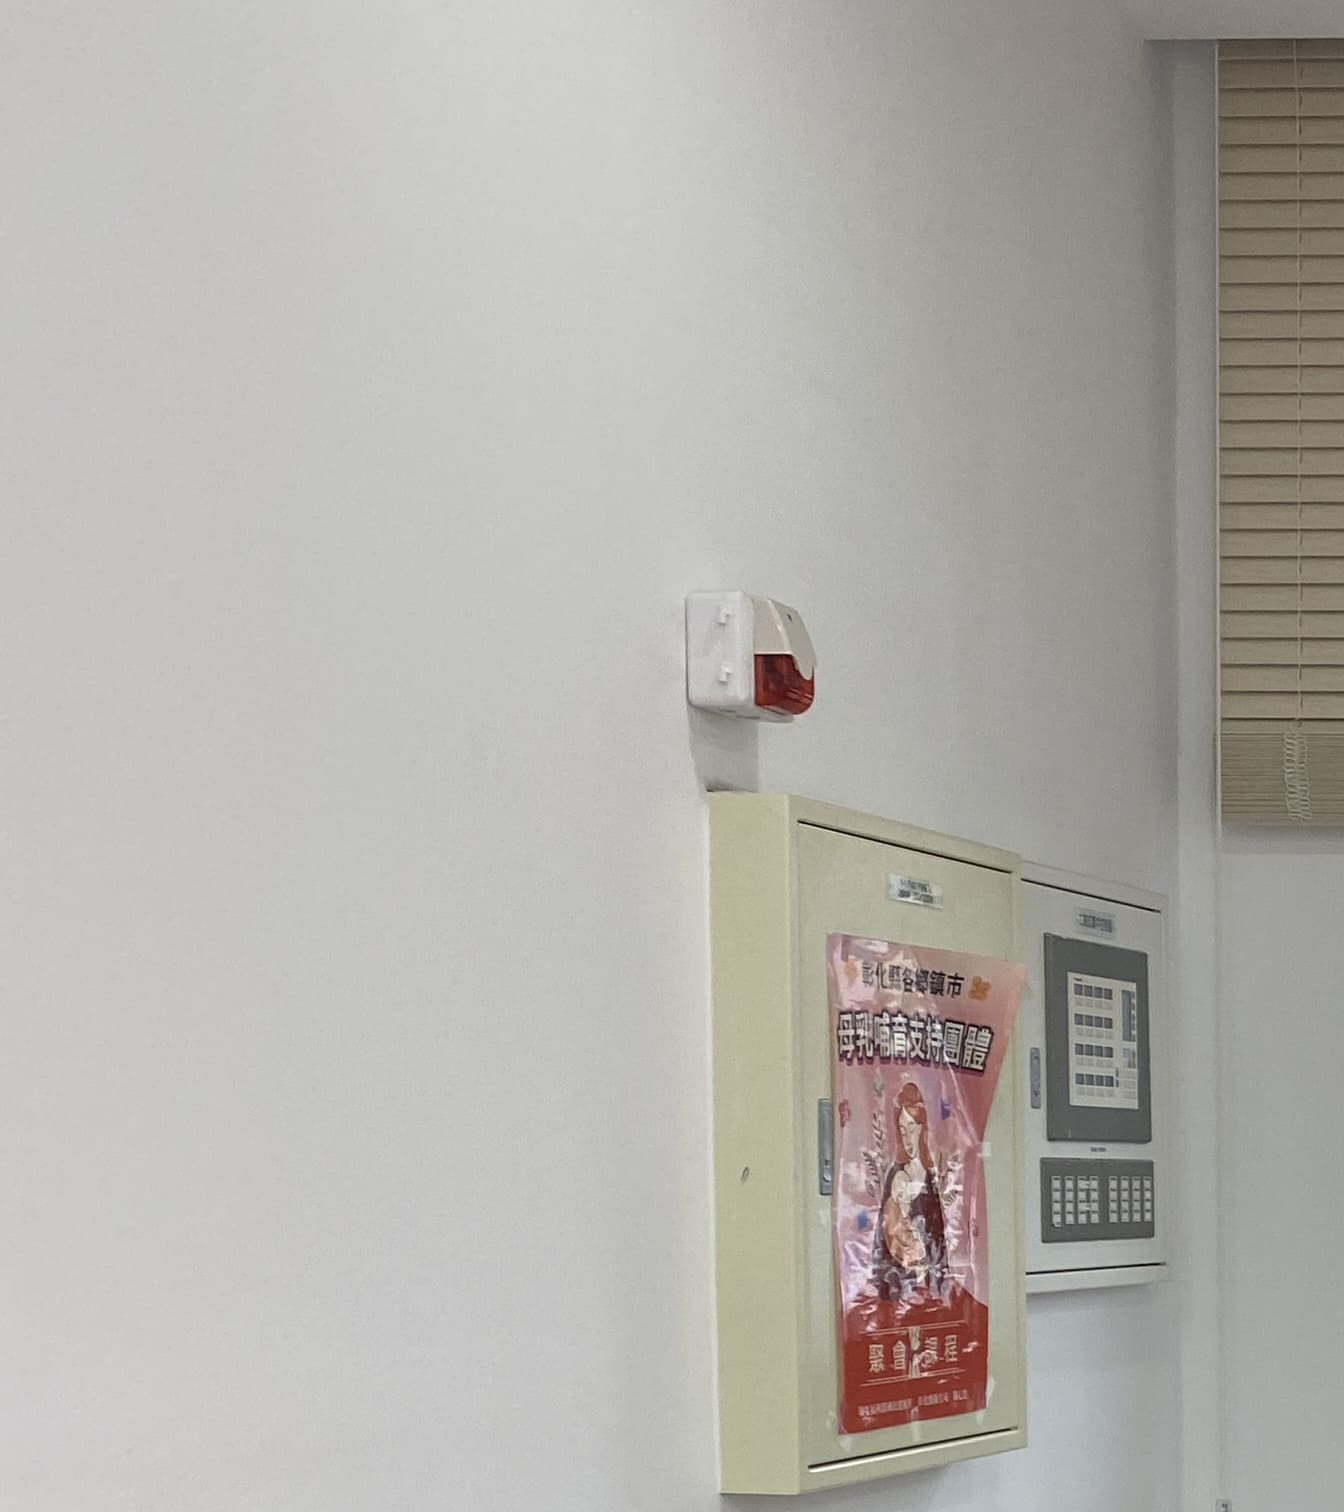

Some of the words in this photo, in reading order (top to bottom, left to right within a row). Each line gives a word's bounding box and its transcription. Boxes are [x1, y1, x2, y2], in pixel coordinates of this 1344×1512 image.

[838, 1010, 992, 1072] 母乳哺育支持團體
